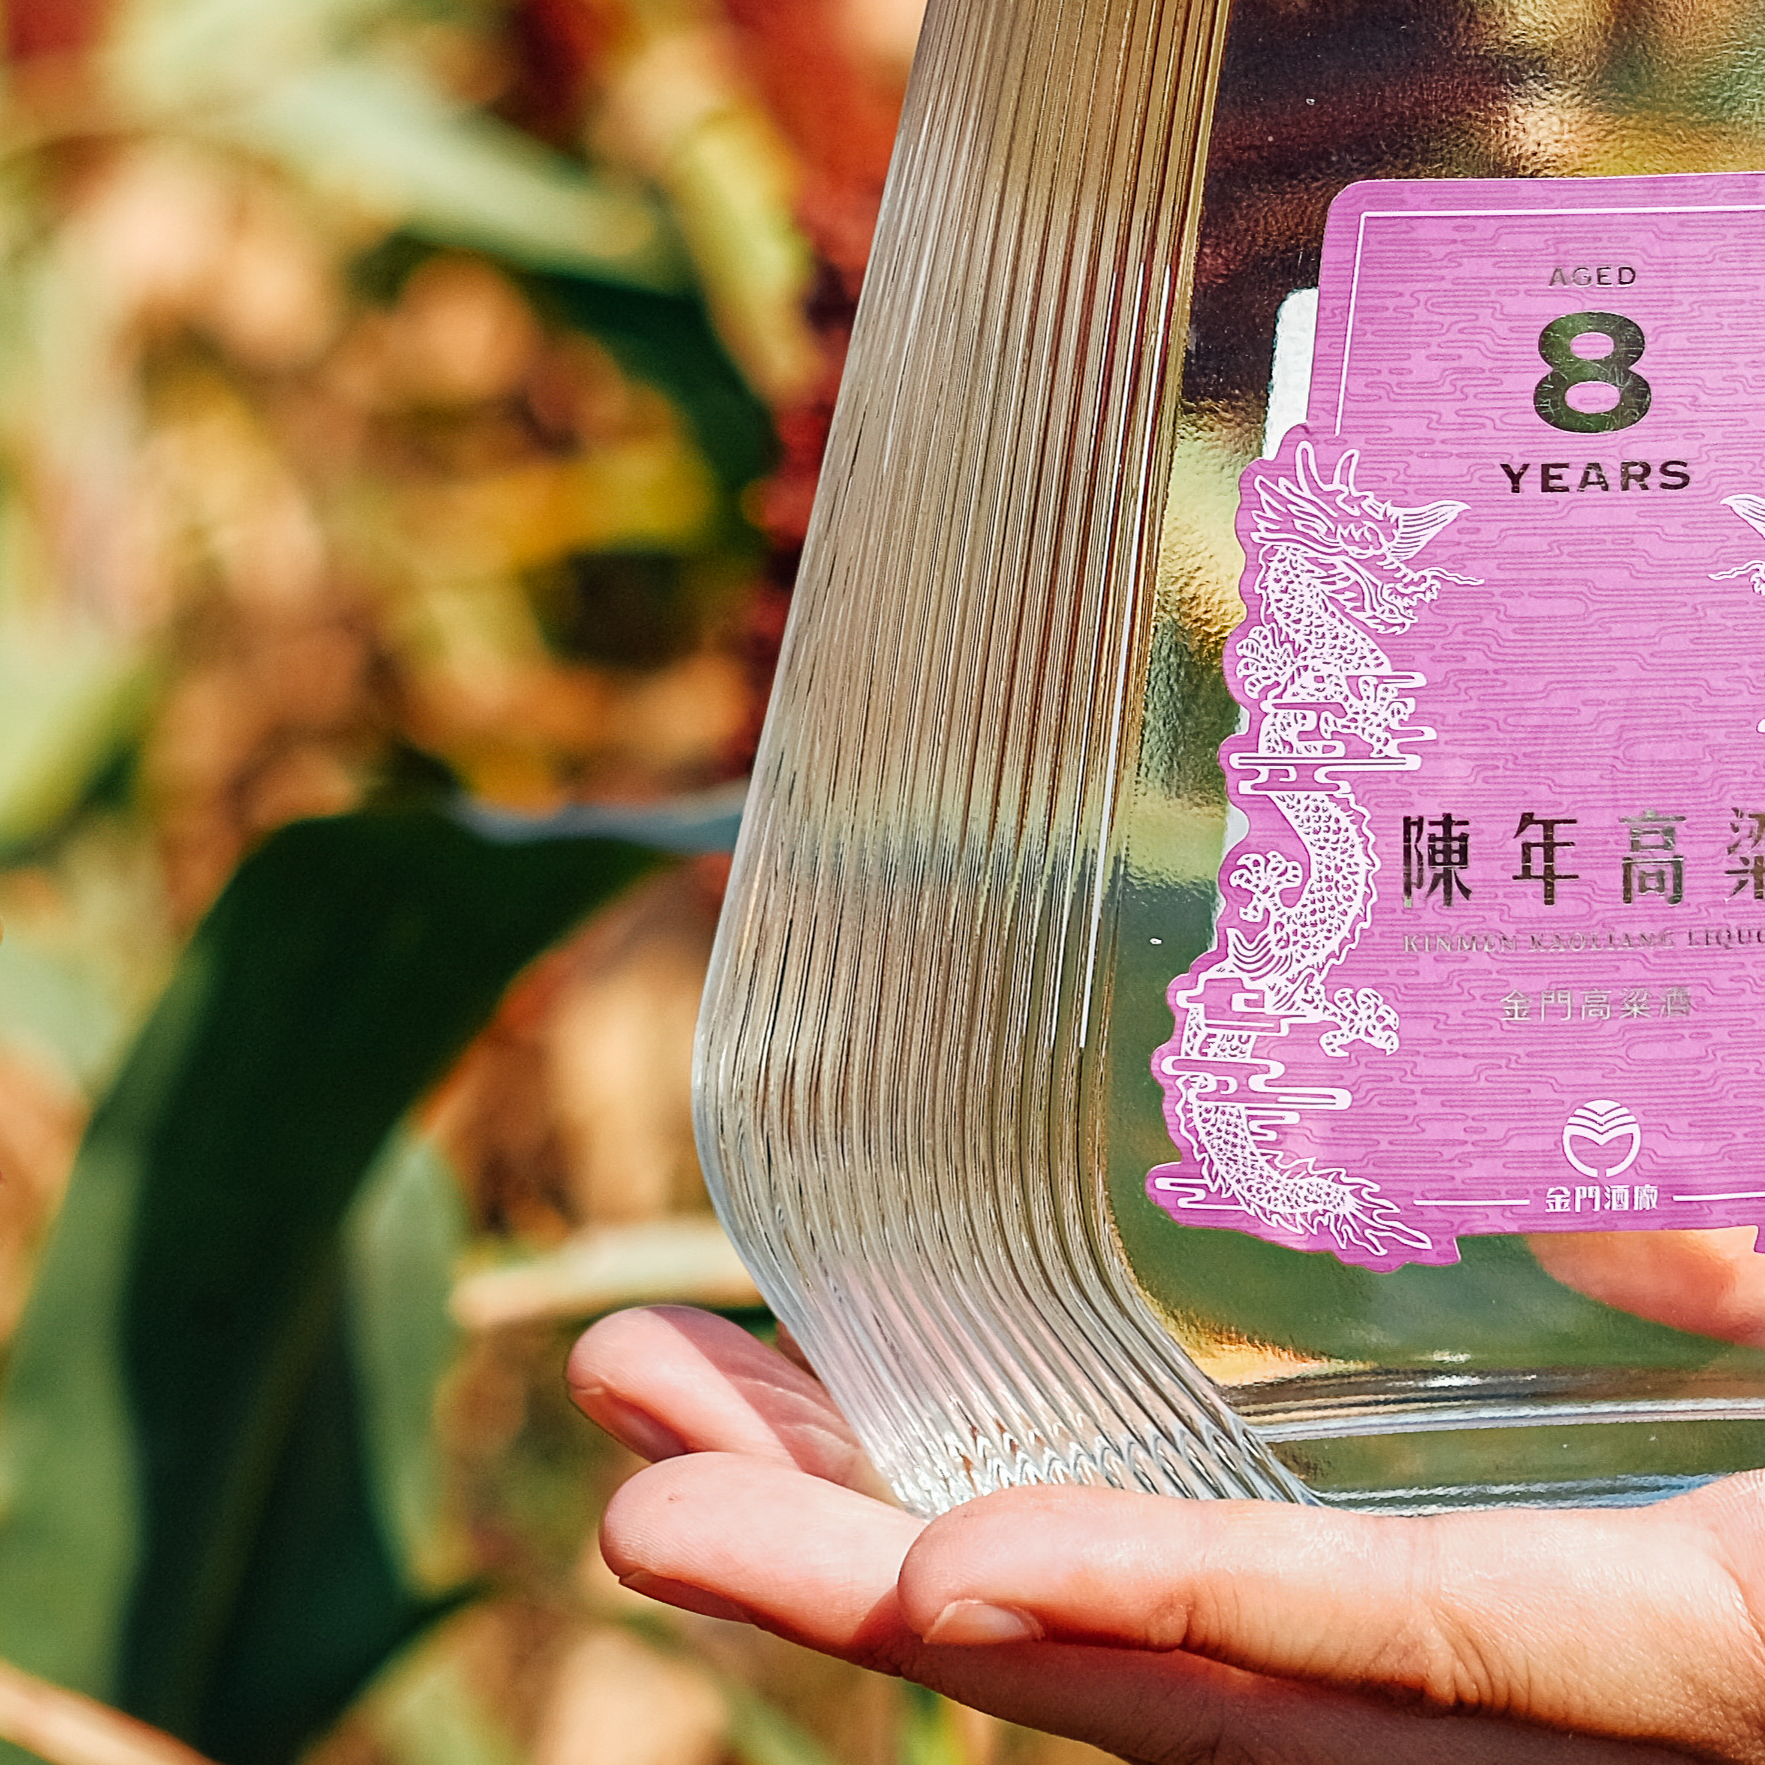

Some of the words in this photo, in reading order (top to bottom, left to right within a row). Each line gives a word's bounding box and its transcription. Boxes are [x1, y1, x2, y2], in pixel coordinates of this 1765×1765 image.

[1548, 266, 1637, 287] AGED
[1533, 311, 1652, 434] 8
[1499, 460, 1691, 494] YEARS
[1403, 932, 1518, 953] KINMEN
[1527, 930, 1676, 953] KAOLIANG
[1500, 986, 1692, 1022] 金門高粱酒
[1544, 1183, 1659, 1213] 金門酒廠
